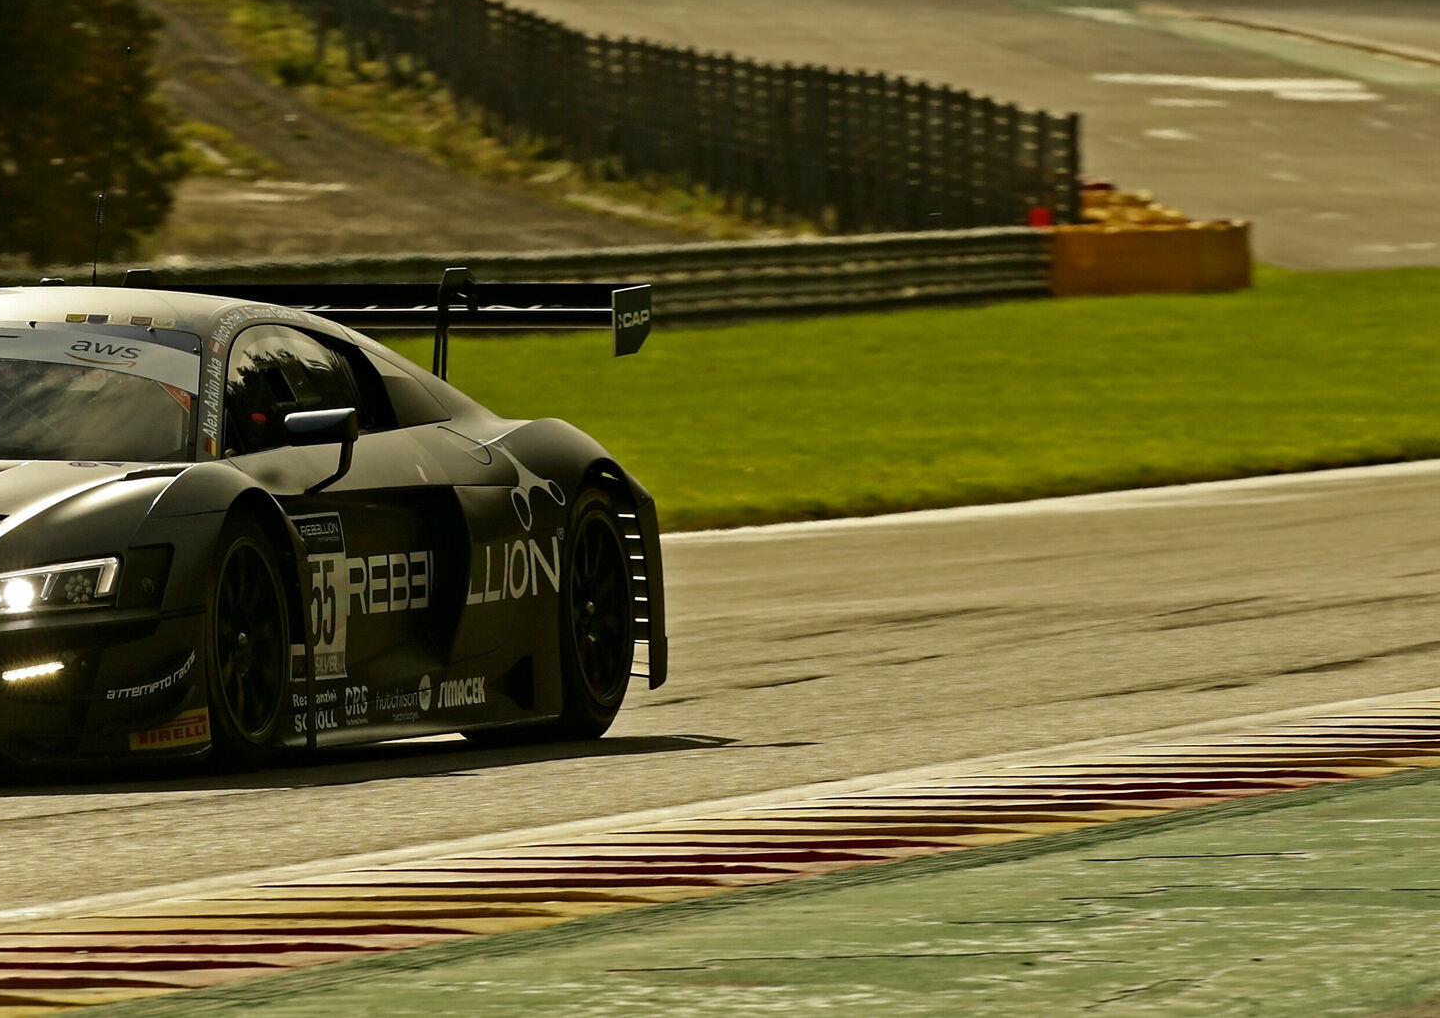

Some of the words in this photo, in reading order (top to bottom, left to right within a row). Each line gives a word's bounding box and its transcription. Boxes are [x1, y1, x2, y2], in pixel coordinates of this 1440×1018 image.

[71, 338, 142, 360] aws
[205, 357, 222, 380] Aka
[203, 379, 221, 412] Arkin
[202, 410, 219, 441] Alex
[309, 560, 337, 646] 55
[138, 716, 207, 745] PIRELLI
